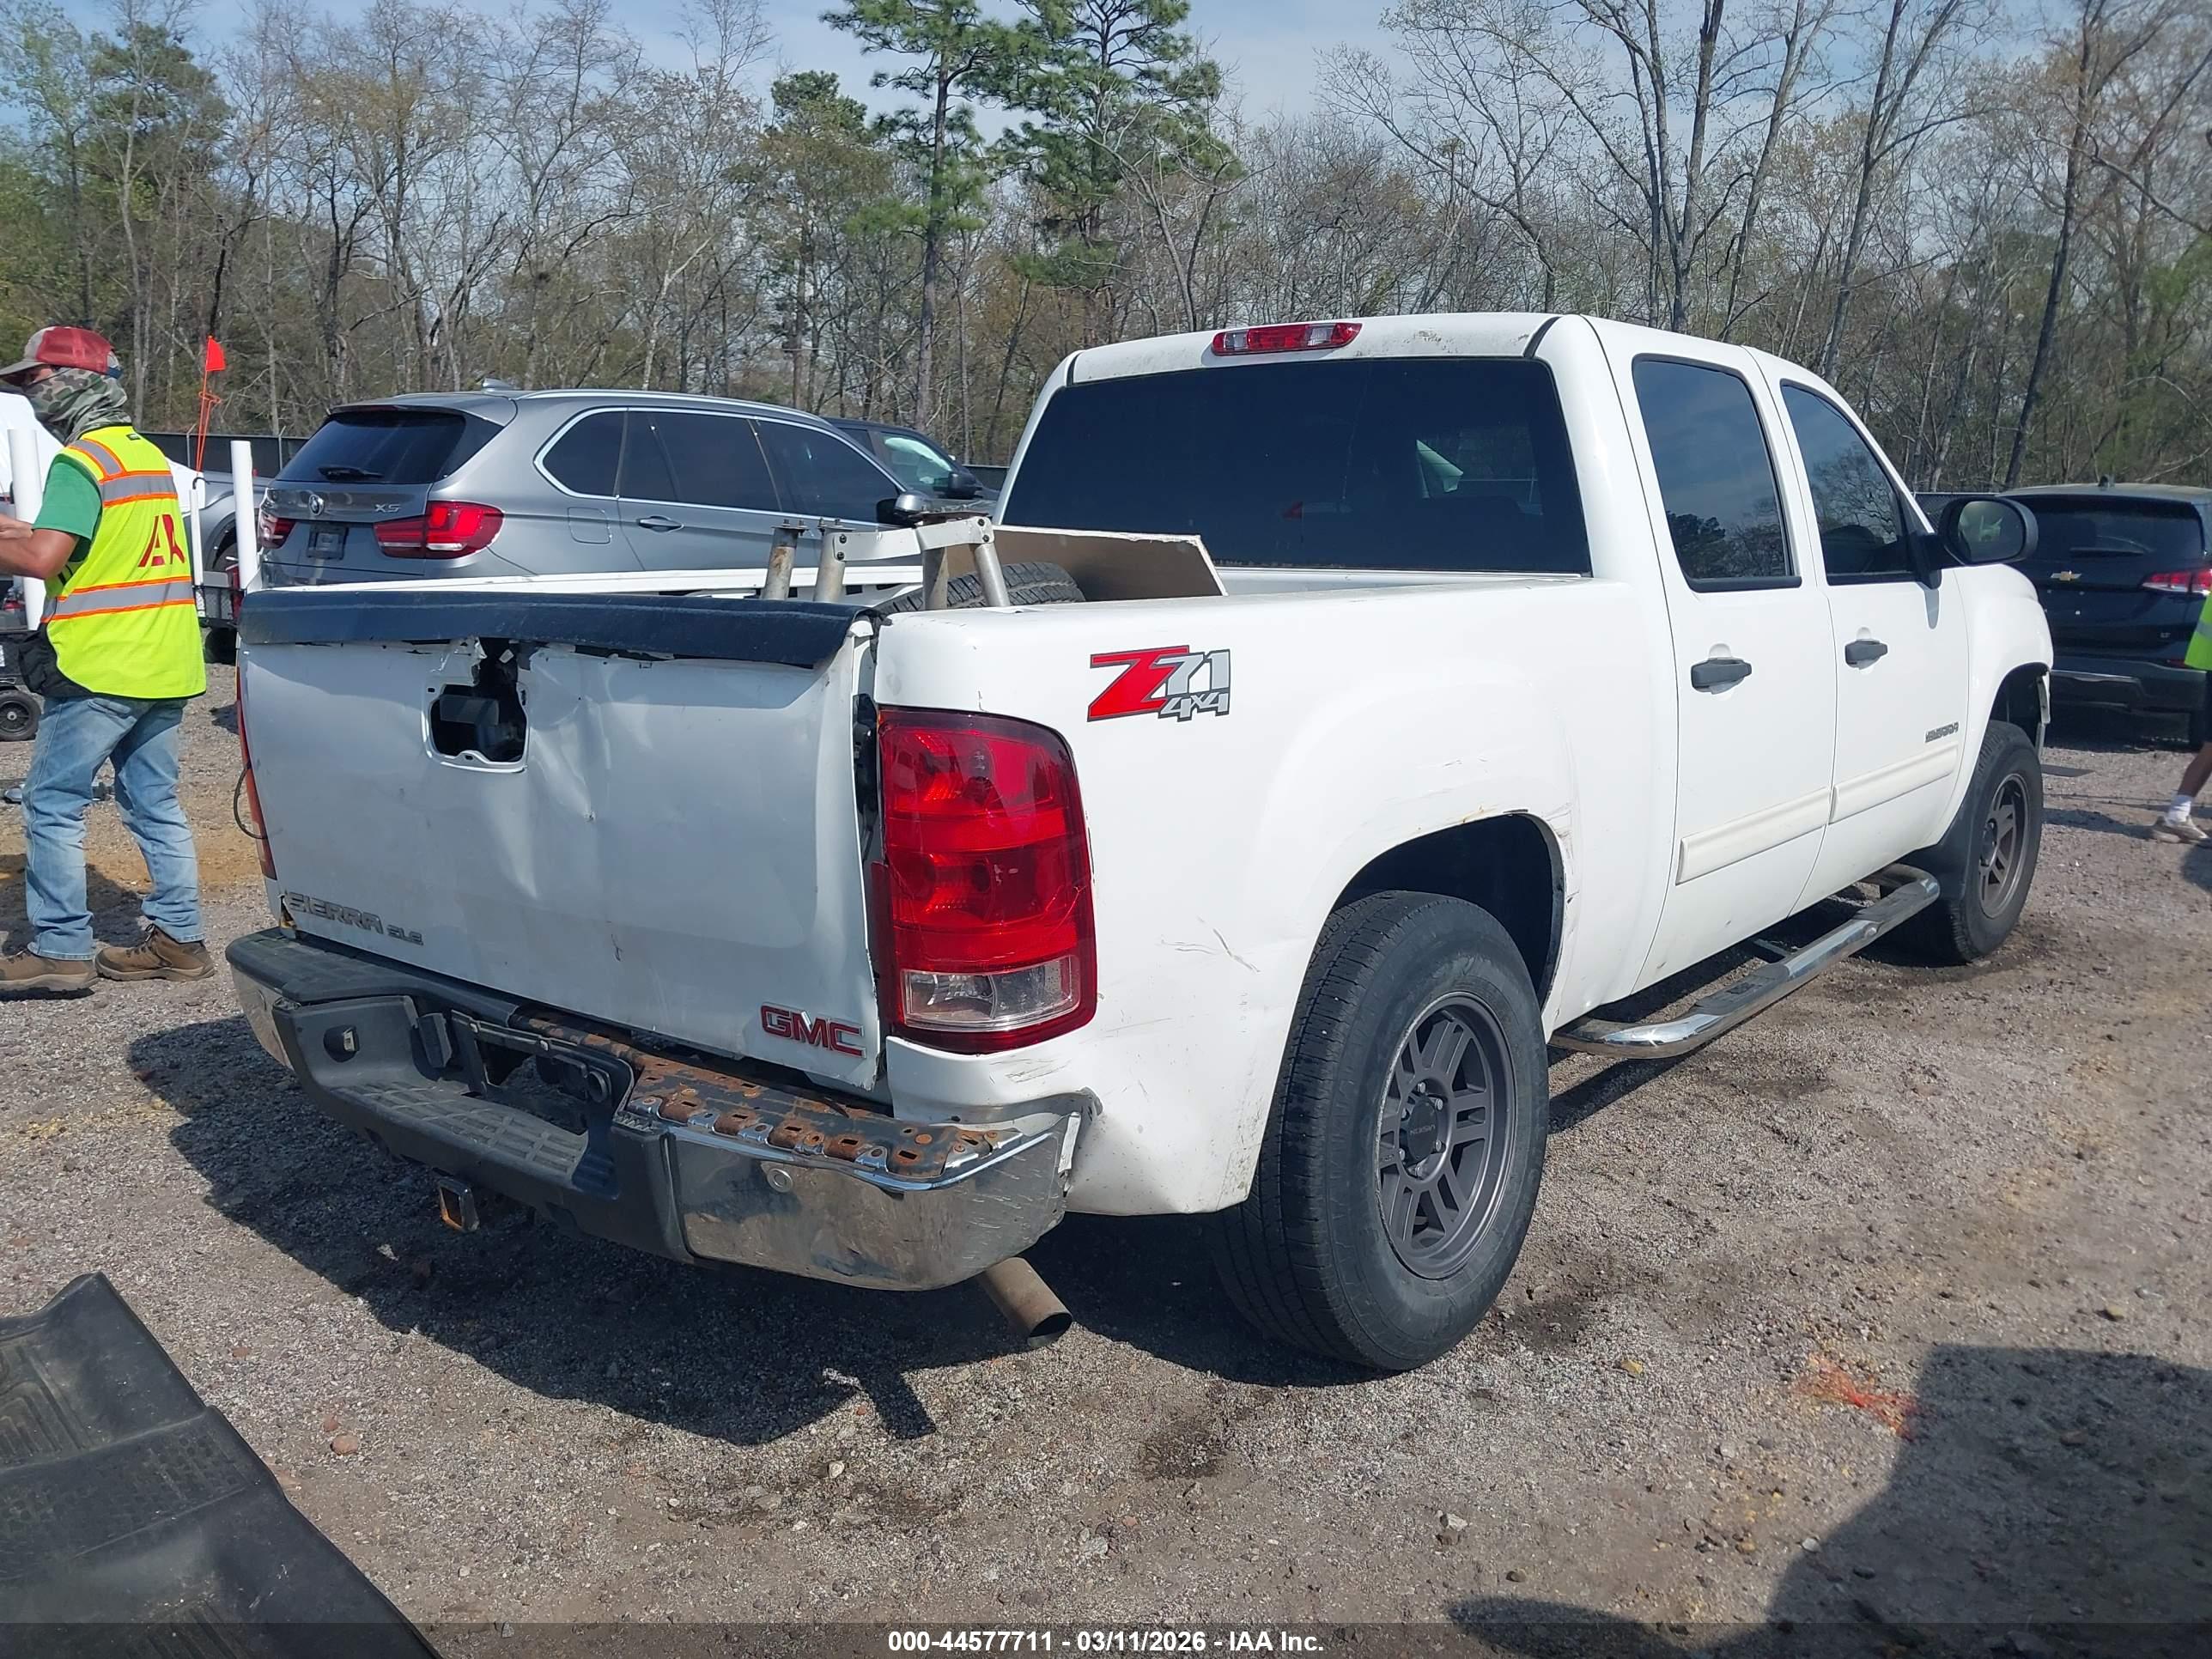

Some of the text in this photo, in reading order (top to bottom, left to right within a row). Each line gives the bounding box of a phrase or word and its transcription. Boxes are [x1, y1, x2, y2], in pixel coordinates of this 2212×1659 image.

[374, 503, 402, 513] X5
[1087, 644, 1231, 722] Z71
[287, 891, 385, 935] SIERRA
[761, 1001, 866, 1059] GMC
